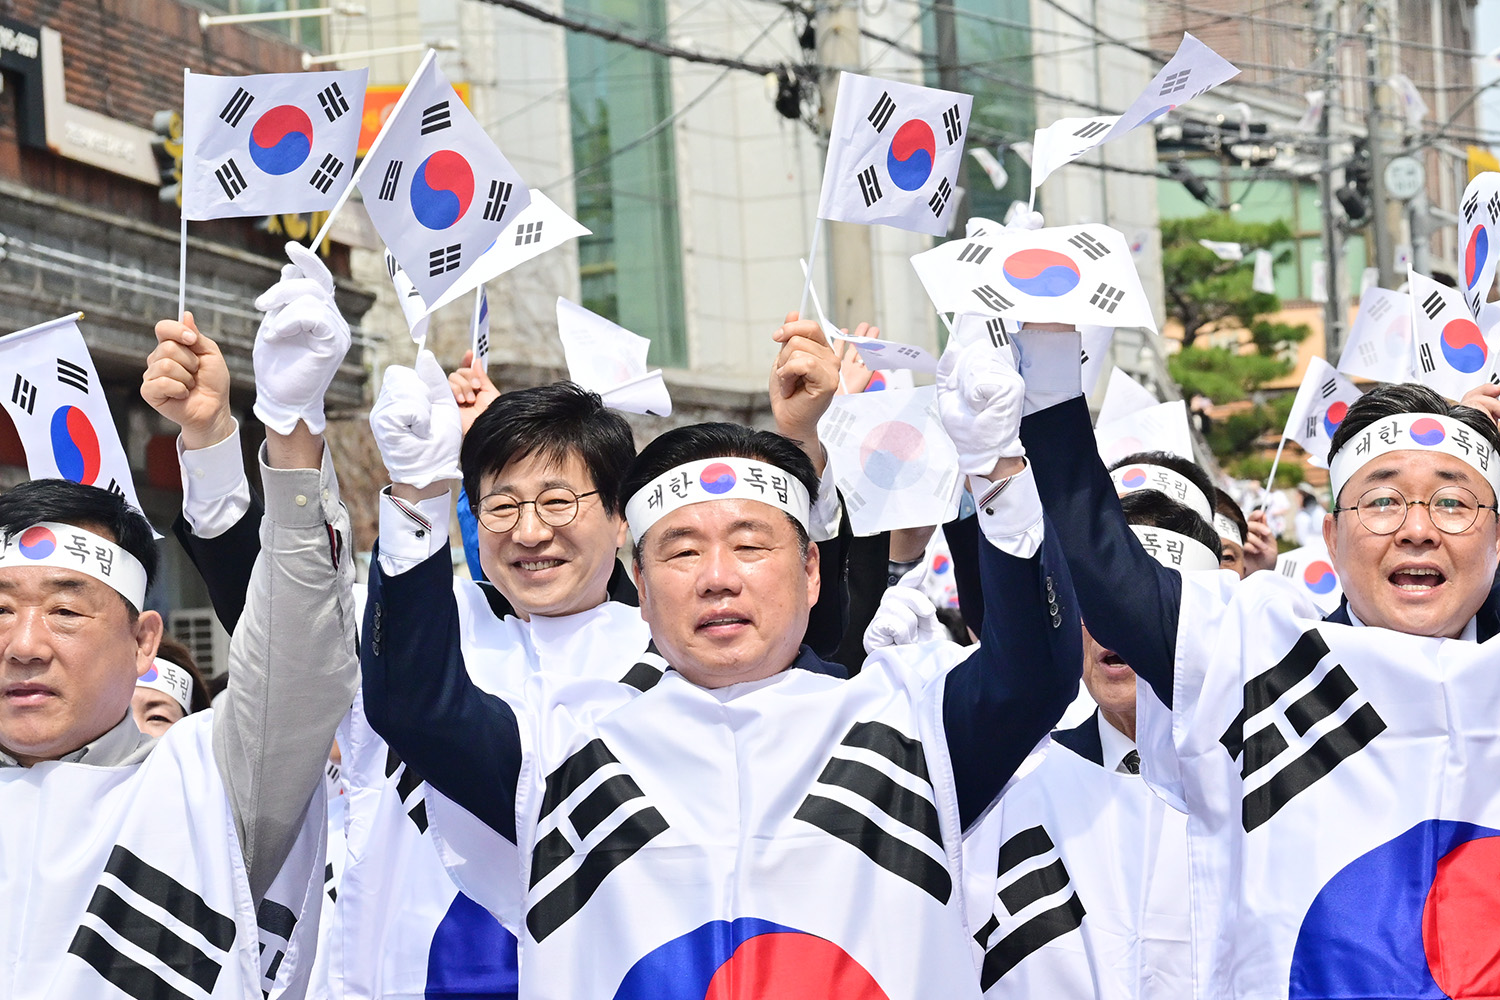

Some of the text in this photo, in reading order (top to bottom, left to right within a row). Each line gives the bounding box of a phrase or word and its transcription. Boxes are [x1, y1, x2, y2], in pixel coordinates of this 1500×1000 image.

[1356, 421, 1490, 472] 대한 독립
[647, 466, 788, 510] 대한 독립
[1152, 471, 1188, 500] 독립
[64, 534, 113, 576] 독립
[1142, 533, 1184, 565] 독립
[162, 667, 190, 701] 독립
